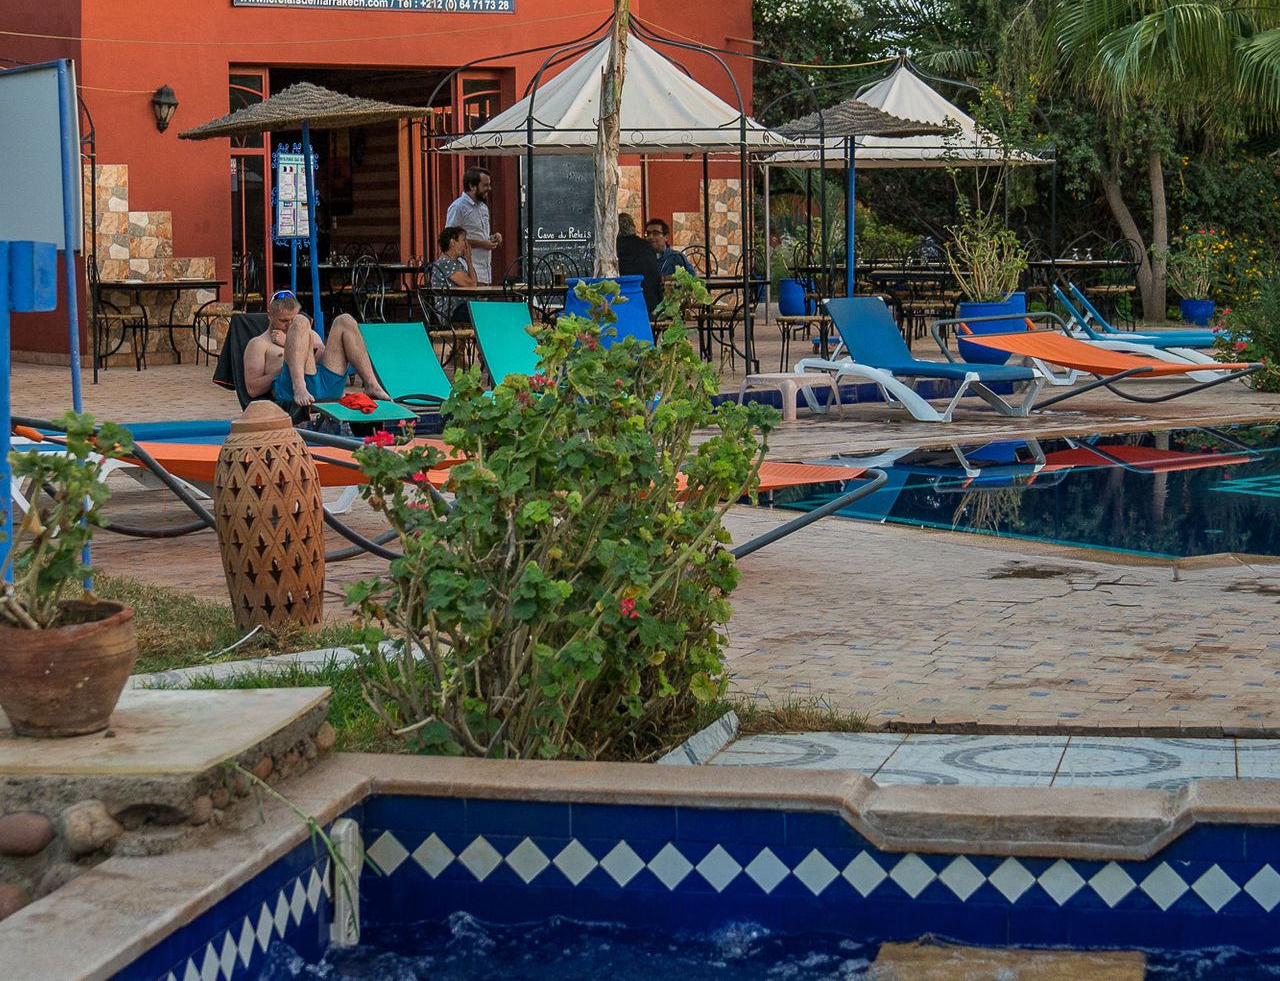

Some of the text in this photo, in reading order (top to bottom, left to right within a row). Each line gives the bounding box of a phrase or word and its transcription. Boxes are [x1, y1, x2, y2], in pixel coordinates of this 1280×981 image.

[420, 0, 442, 9] +212
[445, 0, 457, 11] (0)
[459, 0, 470, 9] 64
[472, 0, 484, 10] 71
[485, 0, 496, 10] 73
[498, 0, 509, 10] 28
[538, 227, 554, 238] Cave
[569, 227, 591, 238] Relais
